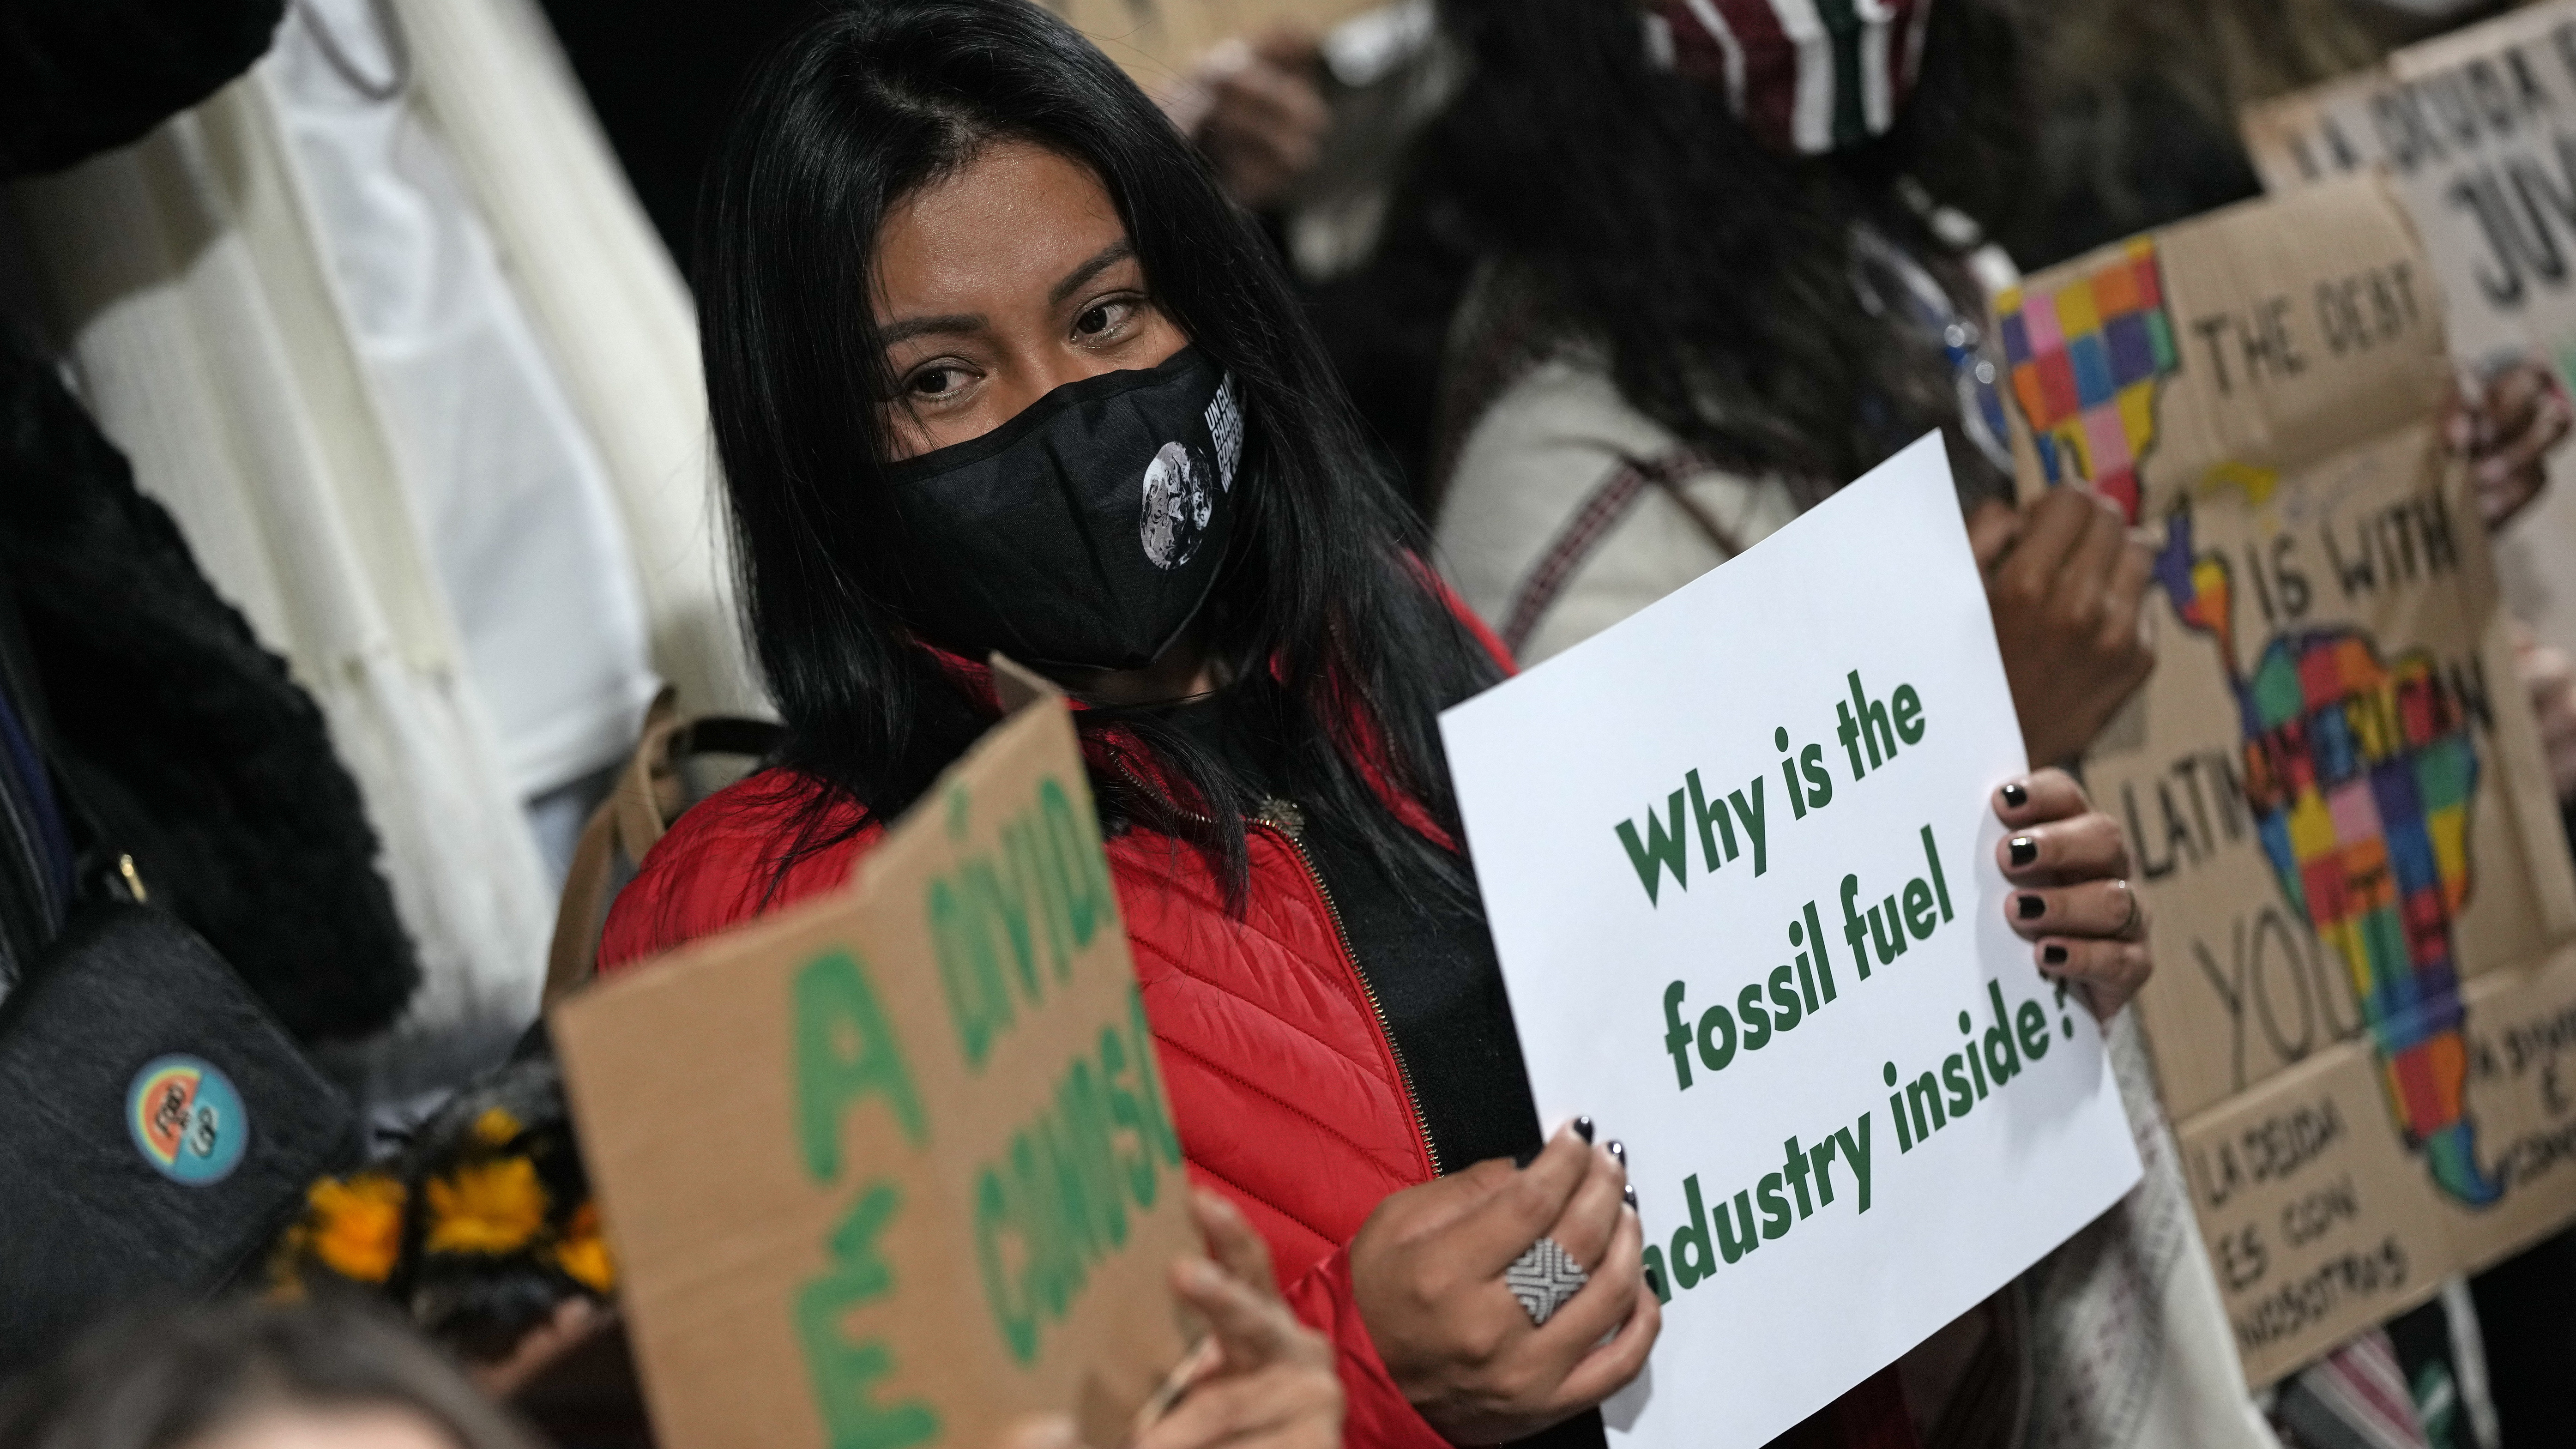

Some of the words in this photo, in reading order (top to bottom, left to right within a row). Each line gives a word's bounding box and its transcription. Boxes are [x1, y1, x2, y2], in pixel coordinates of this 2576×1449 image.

[2191, 296, 2305, 395] THE
[2313, 261, 2423, 358] DEBT
[1204, 398, 1221, 432] UN
[2245, 532, 2309, 620] IS
[2322, 488, 2459, 596] WITH
[1616, 768, 1767, 909] Why
[1774, 726, 1833, 820] is
[1836, 669, 1926, 781] the
[2122, 749, 2250, 880] LATIN
[1663, 899, 1837, 1091] fossil
[1840, 824, 1955, 982] fuel
[792, 946, 925, 1183] A
[1642, 1112, 1871, 1305] ndustry
[2193, 1144, 2243, 1206] LA
[2245, 1098, 2342, 1178] DEUDA
[2222, 1223, 2267, 1291] ES
[2280, 1174, 2359, 1245] CON
[792, 1182, 940, 1449] É
